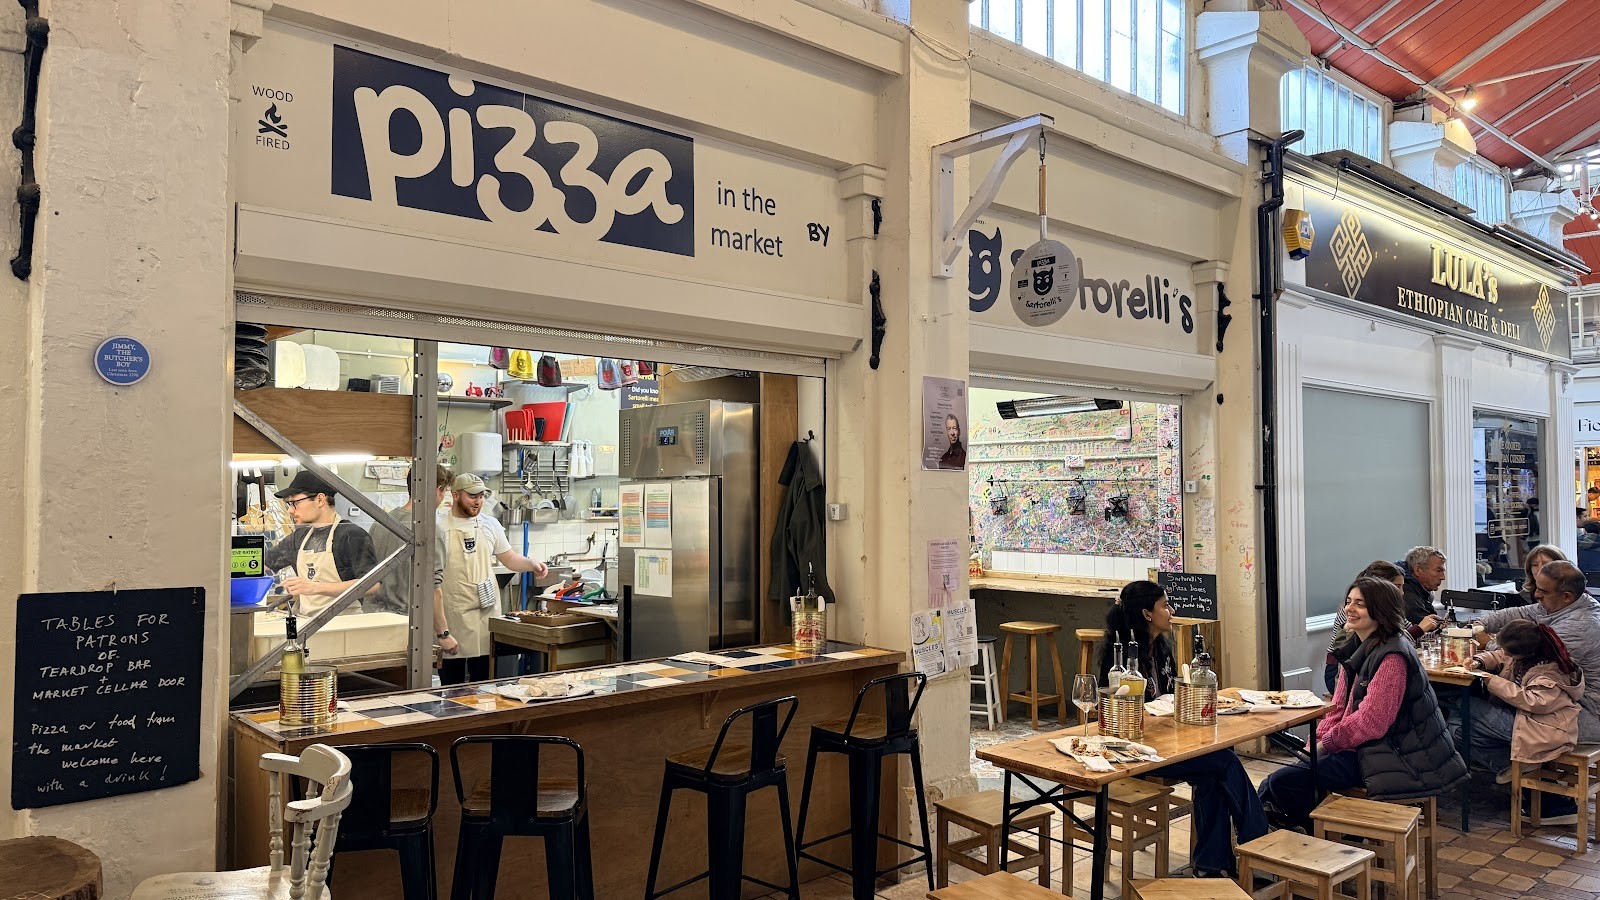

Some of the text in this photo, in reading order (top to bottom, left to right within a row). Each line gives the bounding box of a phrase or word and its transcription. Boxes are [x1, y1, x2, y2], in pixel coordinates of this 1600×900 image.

[252, 84, 294, 103] WOOD
[255, 135, 290, 150] FIRED
[353, 72, 684, 243] pizza
[717, 180, 777, 216] in the
[711, 223, 784, 258] market
[807, 221, 831, 247] BY
[1431, 243, 1499, 304] LULA's
[1025, 296, 1062, 309] Sartorelli's
[1397, 286, 1521, 341] ETHIOPIAN CAFÉ & DELI
[631, 385, 641, 393] Did
[641, 387, 650, 395] you
[41, 613, 170, 632] TABLES FOR
[76, 631, 150, 650] PATRONS
[914, 644, 938, 655] MUSCLES
[40, 659, 152, 679] TEARDROP BAR
[33, 676, 186, 701] MARKET CELLAR DOOR
[99, 675, 109, 685] +
[31, 711, 176, 735] Pizza or food from
[28, 737, 119, 756] the market
[61, 751, 162, 769] welcome here
[37, 764, 168, 794] with a drink !
